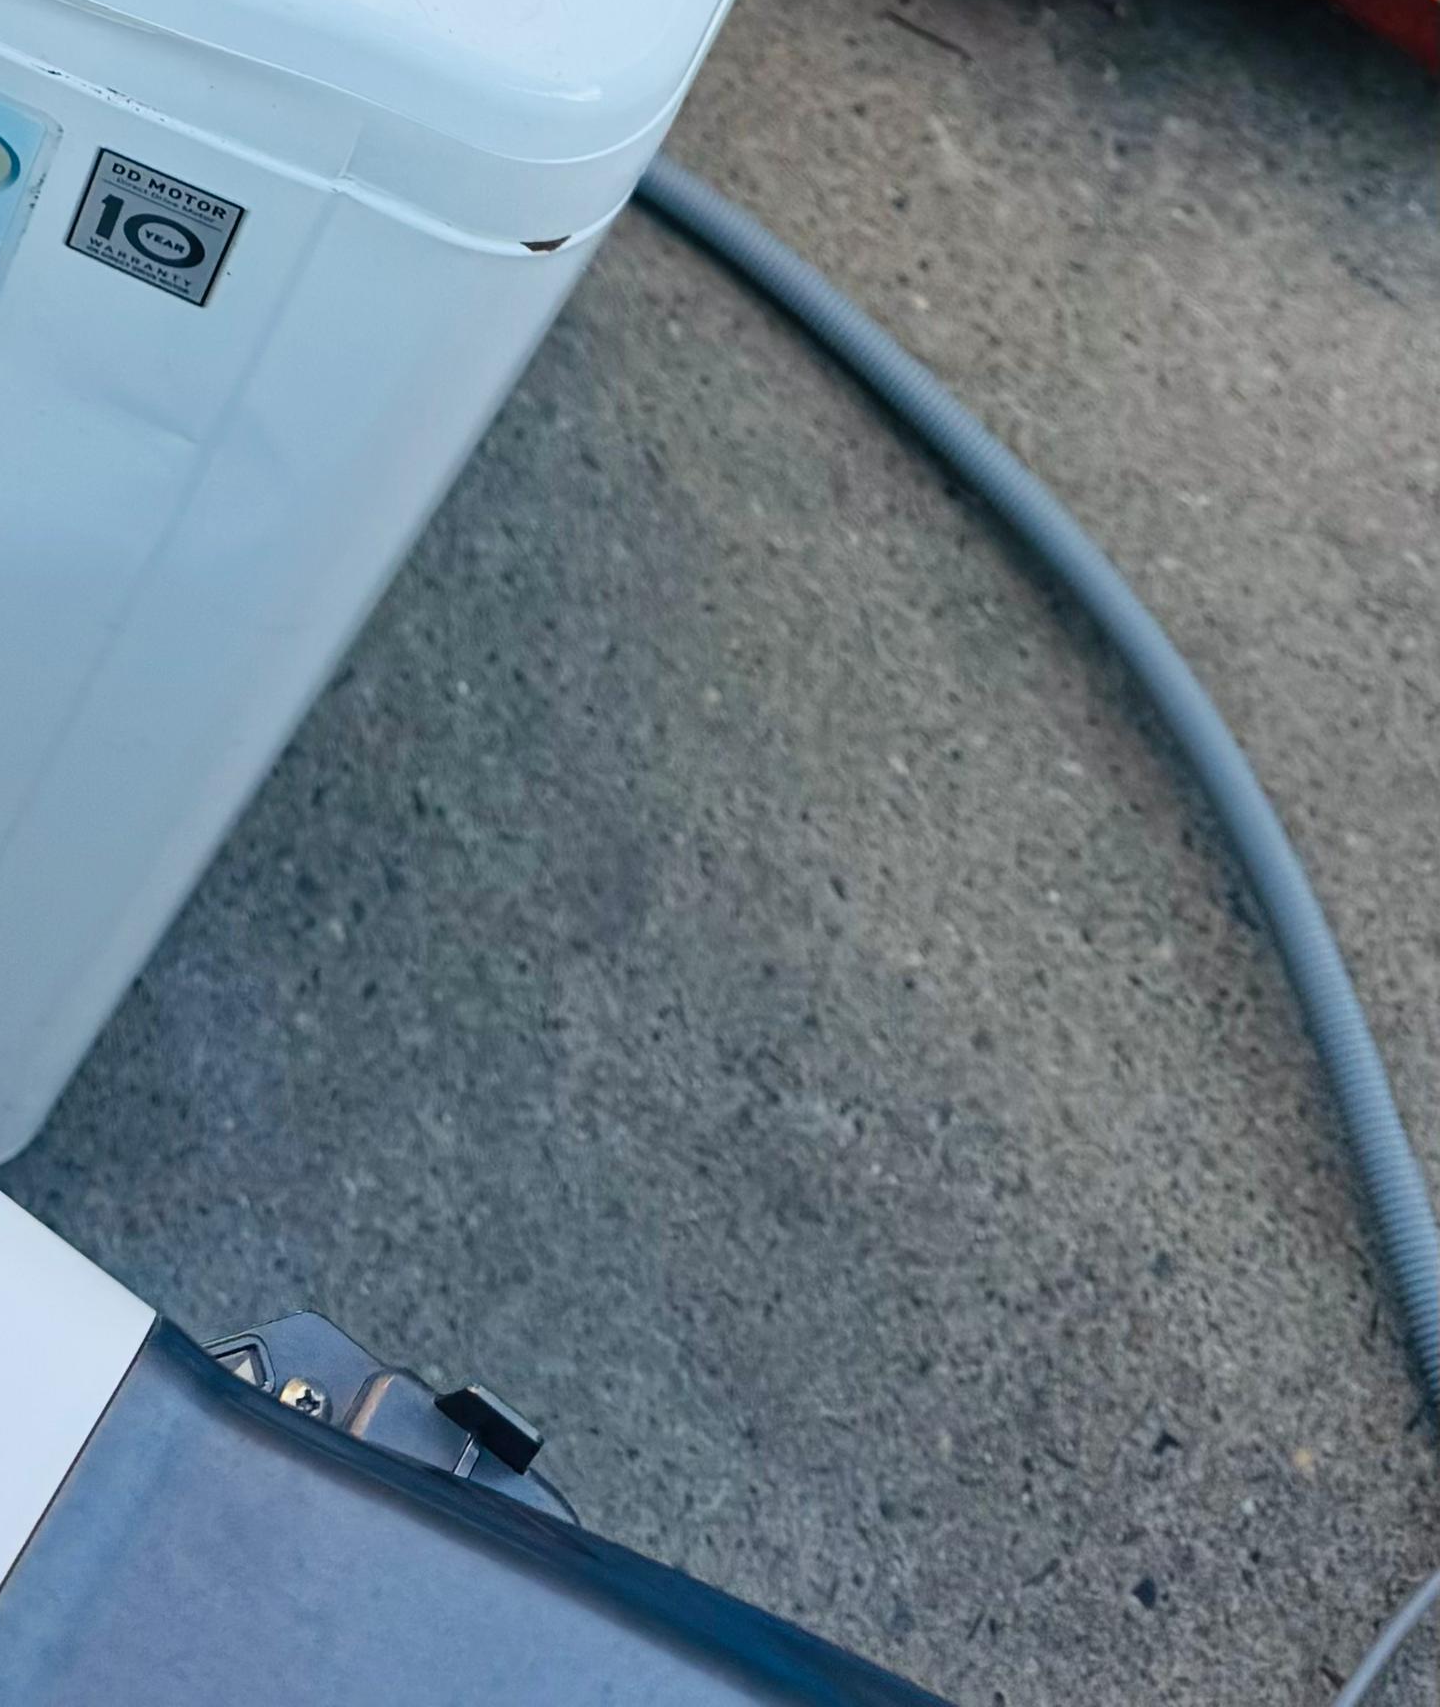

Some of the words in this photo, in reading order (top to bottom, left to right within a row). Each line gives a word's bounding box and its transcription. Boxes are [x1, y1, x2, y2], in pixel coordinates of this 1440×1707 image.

[112, 162, 141, 182] DD
[148, 177, 228, 220] MOTOR
[96, 193, 206, 269] 10
[144, 229, 186, 254] YEAR
[89, 237, 192, 287] WARRANTY
